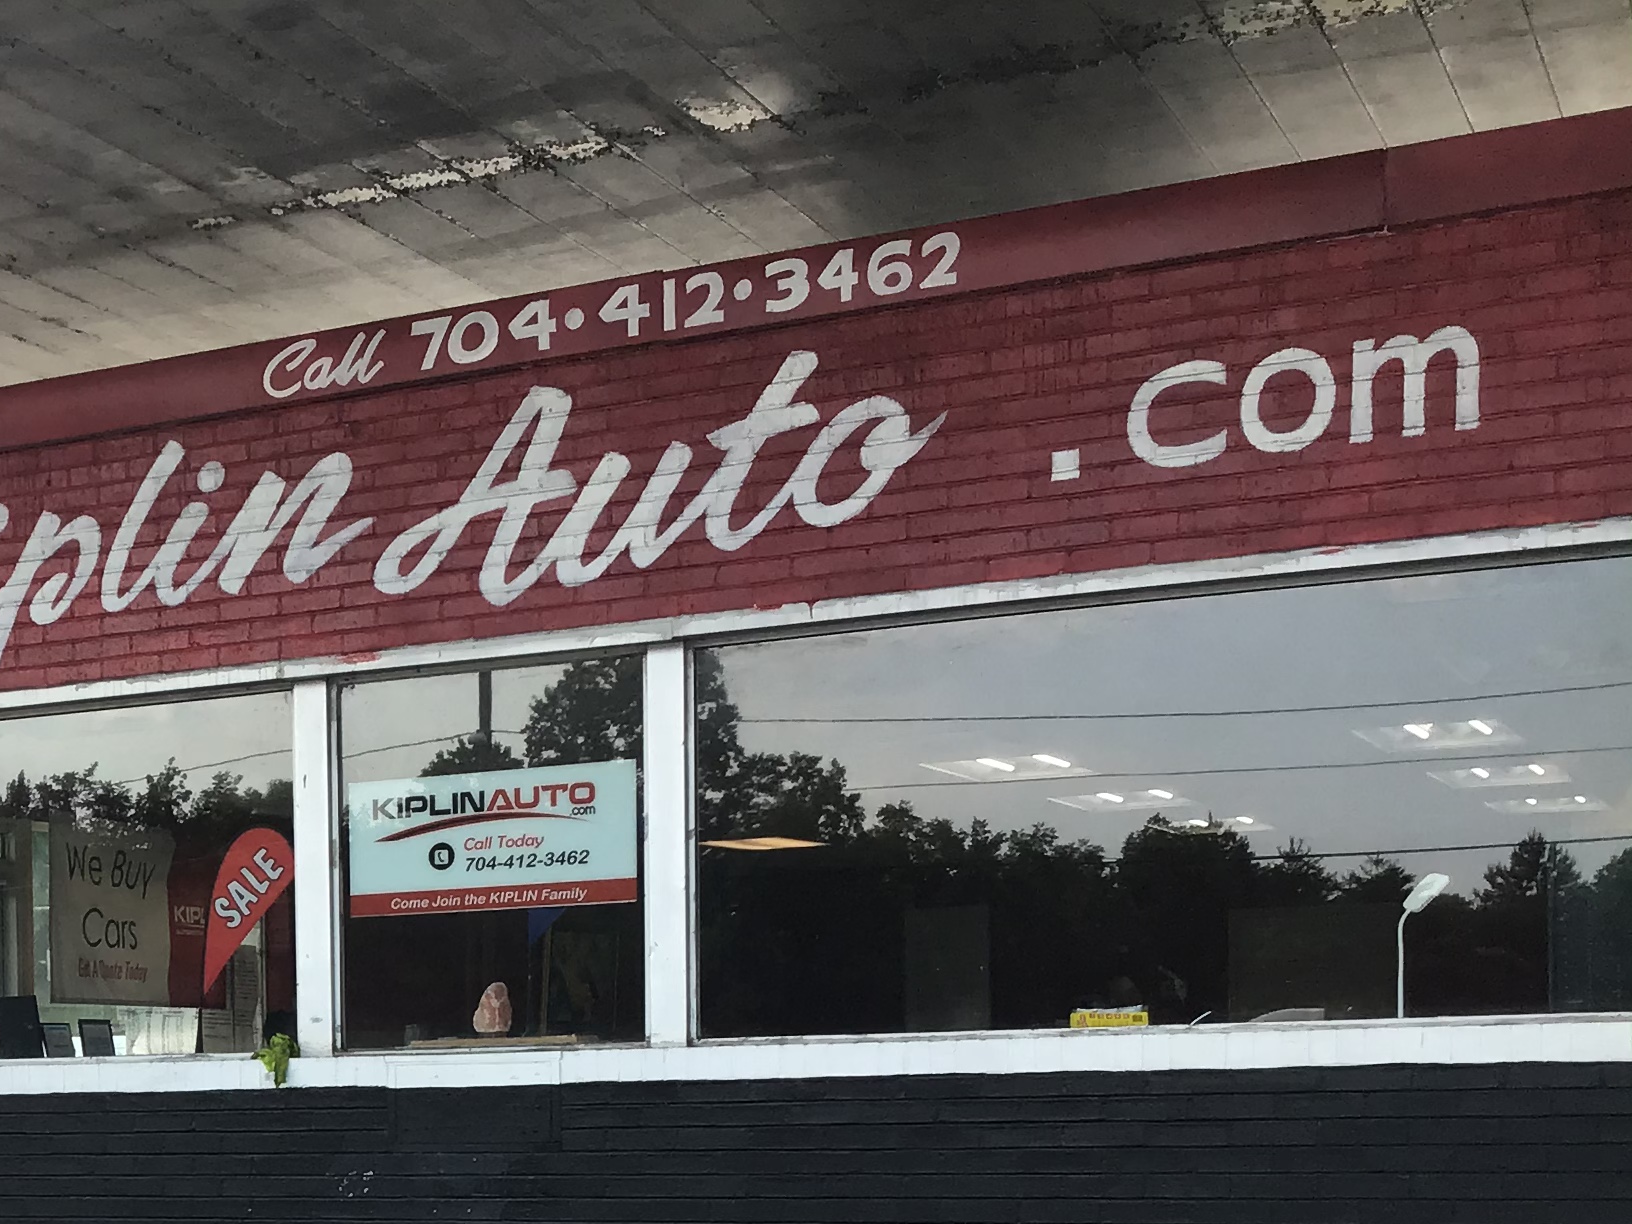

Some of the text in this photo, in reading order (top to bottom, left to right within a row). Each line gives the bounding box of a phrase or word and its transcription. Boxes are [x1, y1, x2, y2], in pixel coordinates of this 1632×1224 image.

[262, 328, 386, 399] Call
[373, 349, 948, 607] Auto
[569, 805, 596, 817] .com
[464, 834, 544, 851] Call Today
[66, 842, 103, 887] We
[465, 849, 590, 872] 704-412-3462
[214, 847, 286, 929] SALE
[390, 886, 587, 910] Come Join the KIPLIN Family
[174, 905, 206, 924] KIPL
[82, 907, 138, 950] Cars
[125, 960, 148, 983] Today
